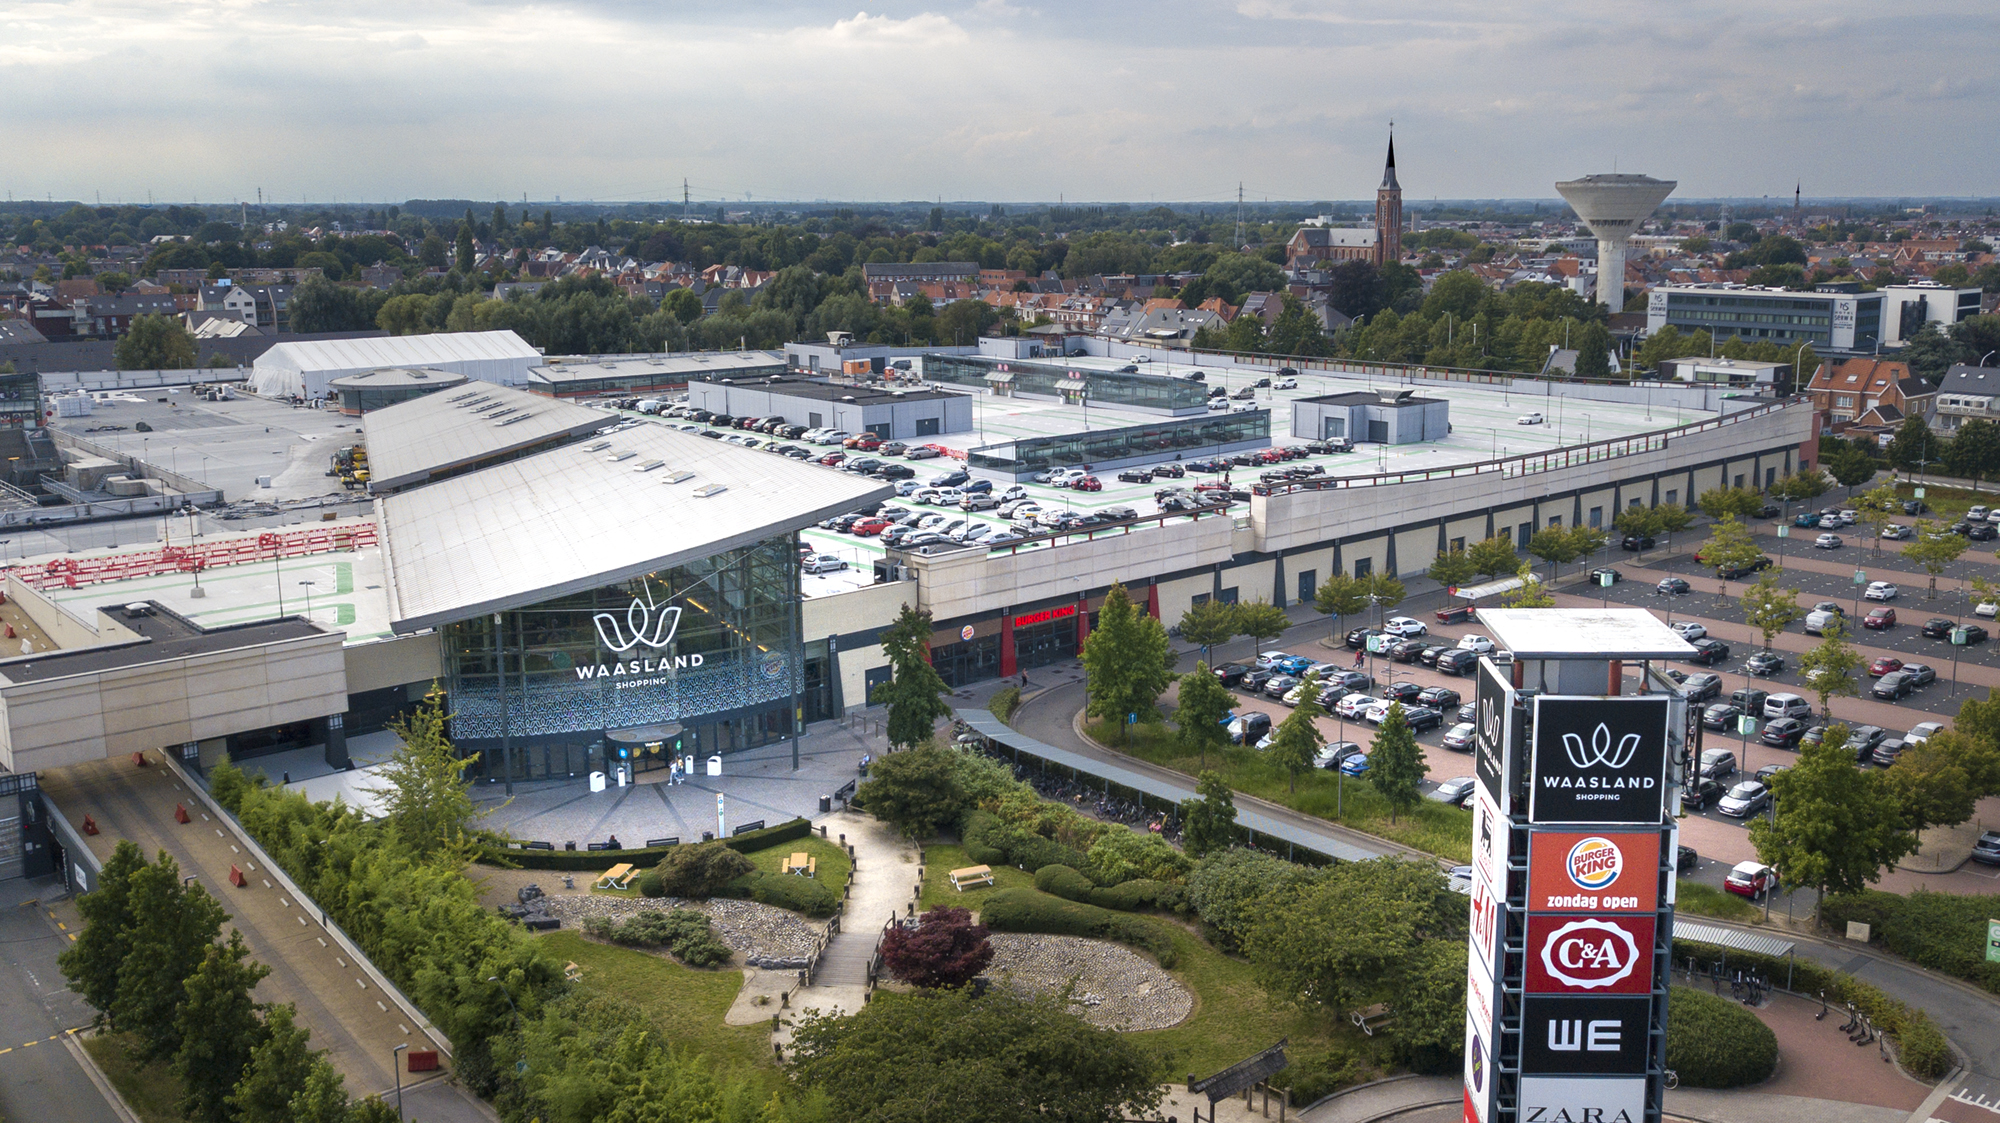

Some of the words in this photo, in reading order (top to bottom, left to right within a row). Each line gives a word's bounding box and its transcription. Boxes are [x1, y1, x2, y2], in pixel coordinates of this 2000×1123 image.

[1015, 611, 1051, 627] BURGER
[1052, 605, 1075, 619] KING
[575, 654, 704, 680] WAASLAND
[615, 677, 667, 690] SHOPPING
[1479, 733, 1502, 775] WAASLAND
[1543, 776, 1655, 789] WAASLAND
[1575, 793, 1621, 801] SHOPPING
[1574, 847, 1615, 866] BURGER
[1575, 856, 1616, 879] KING
[1547, 893, 1598, 909] zondag
[1602, 896, 1638, 910] open
[1472, 878, 1495, 962] H&M
[1558, 938, 1622, 969] C&A
[1548, 1019, 1622, 1051] WE
[1526, 1106, 1633, 1123] ZARA
